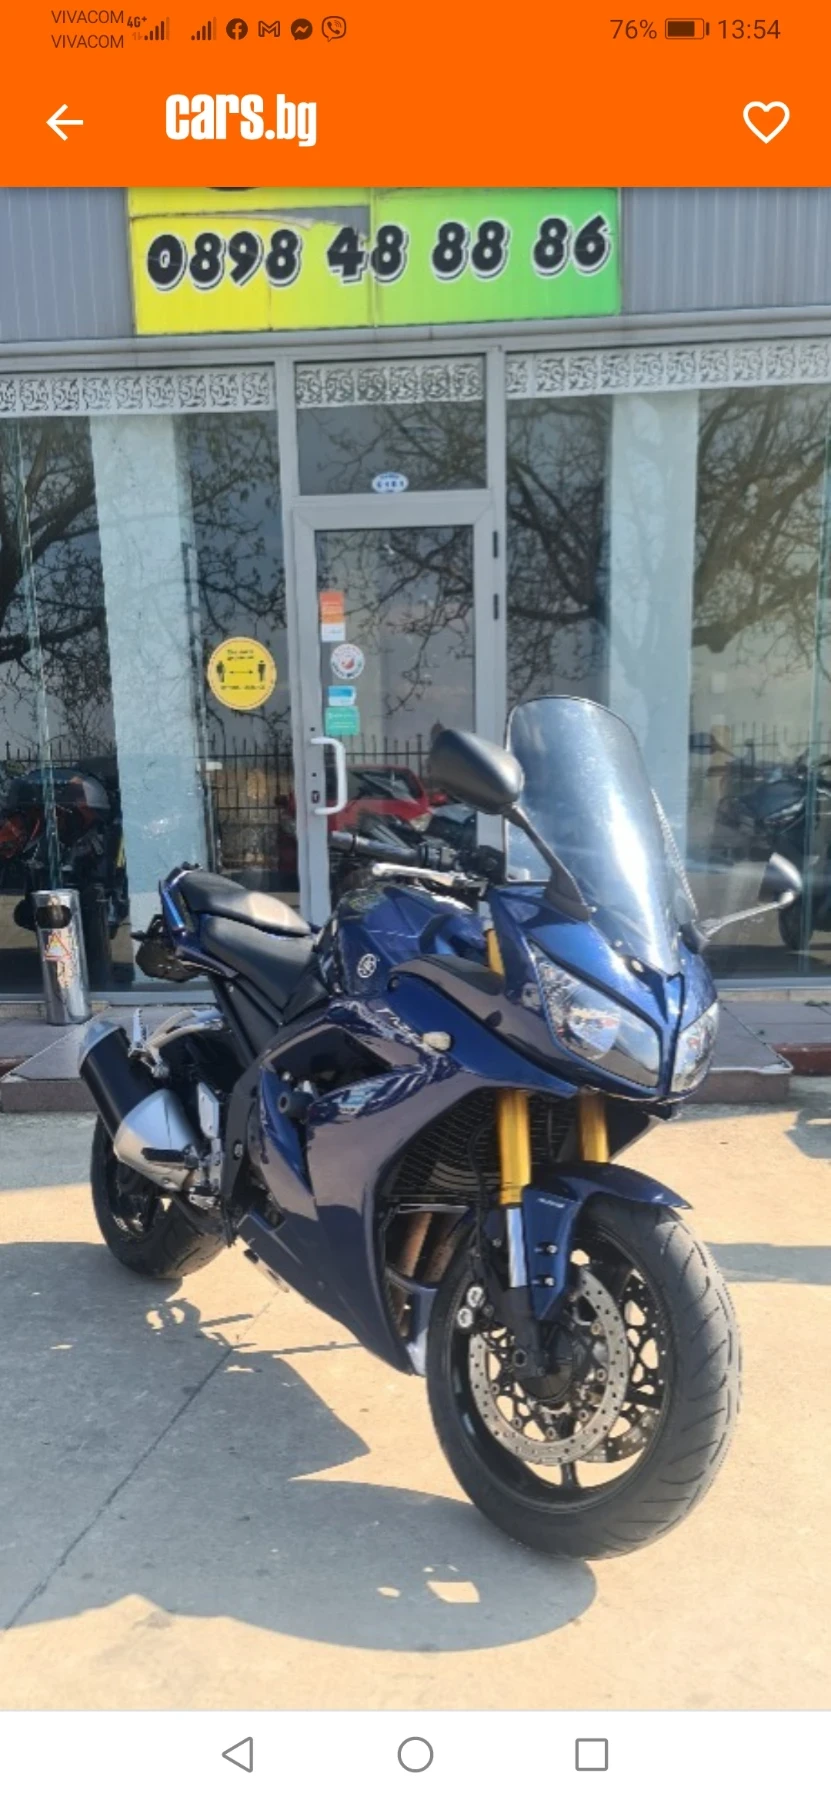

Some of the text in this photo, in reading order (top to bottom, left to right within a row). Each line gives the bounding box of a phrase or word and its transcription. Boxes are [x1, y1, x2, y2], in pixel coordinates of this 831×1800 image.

[147, 214, 612, 291] 0898 48 88 86
